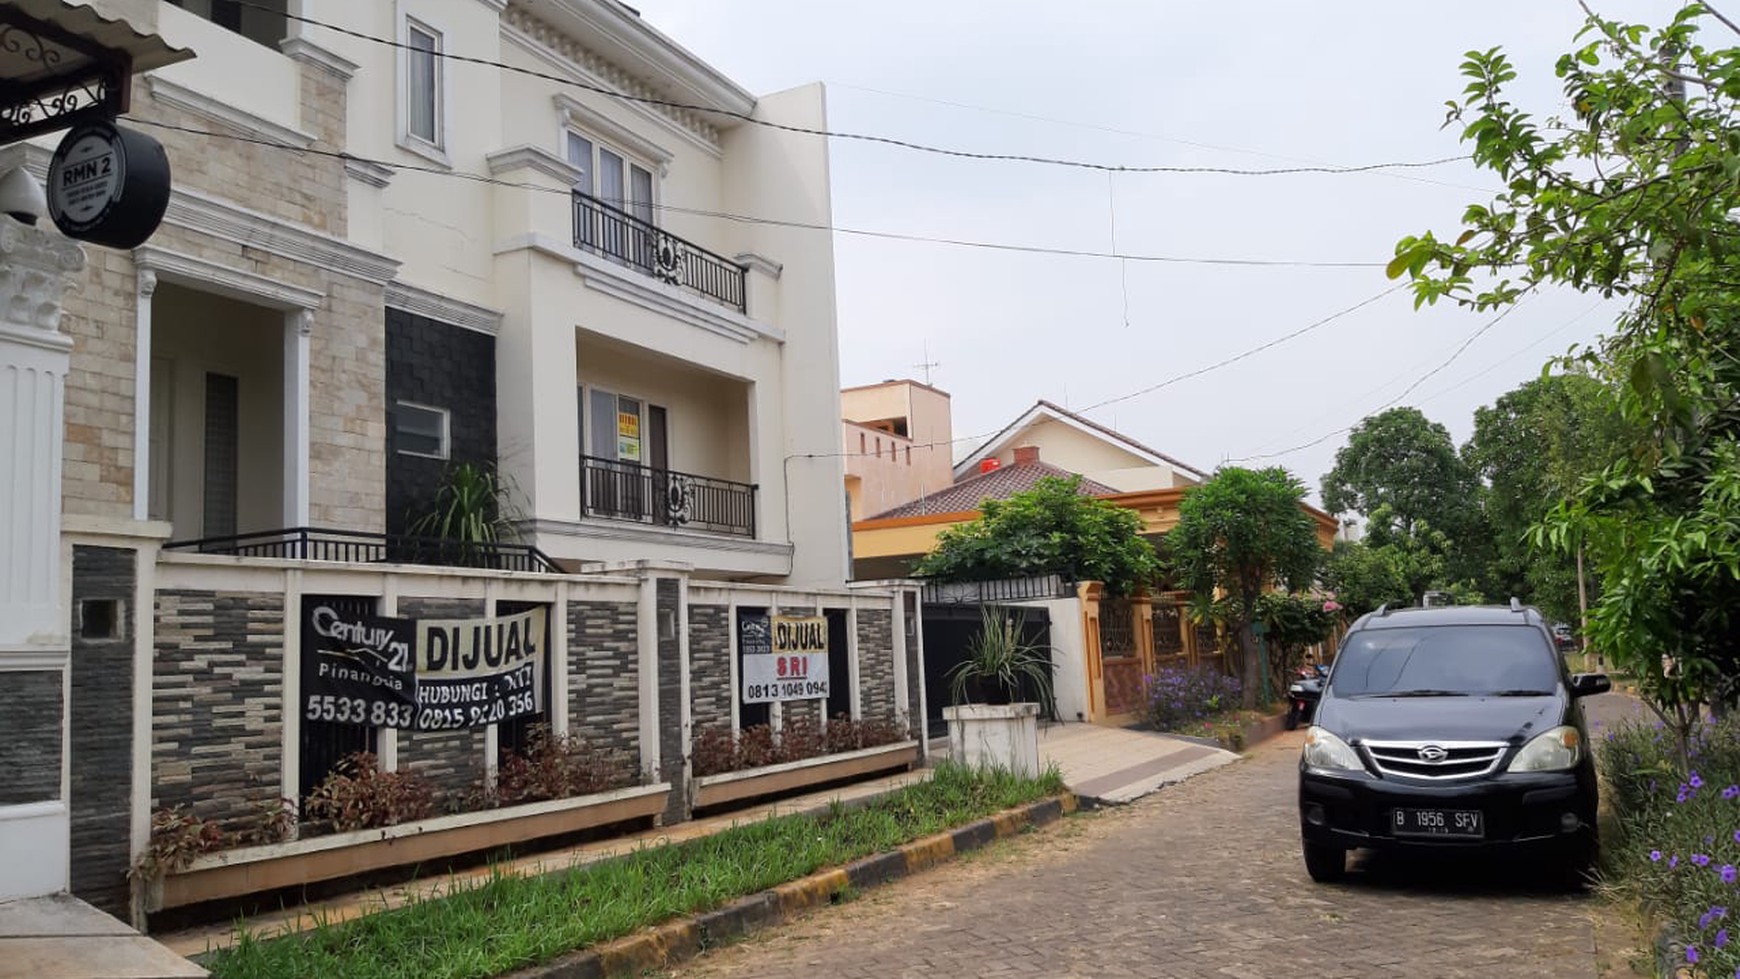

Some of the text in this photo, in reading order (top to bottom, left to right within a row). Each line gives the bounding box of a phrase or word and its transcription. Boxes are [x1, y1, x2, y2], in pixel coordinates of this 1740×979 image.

[63, 157, 111, 187] RMN 2
[312, 606, 409, 672] Century 21
[427, 617, 536, 671] DIJUAL
[775, 622, 824, 650] DIJUAL
[777, 656, 808, 676] SRI
[419, 682, 488, 704] HUBUNGI
[748, 683, 779, 698] 0813
[306, 695, 366, 723] 5533
[1396, 811, 1477, 827] B 1956 SFV
